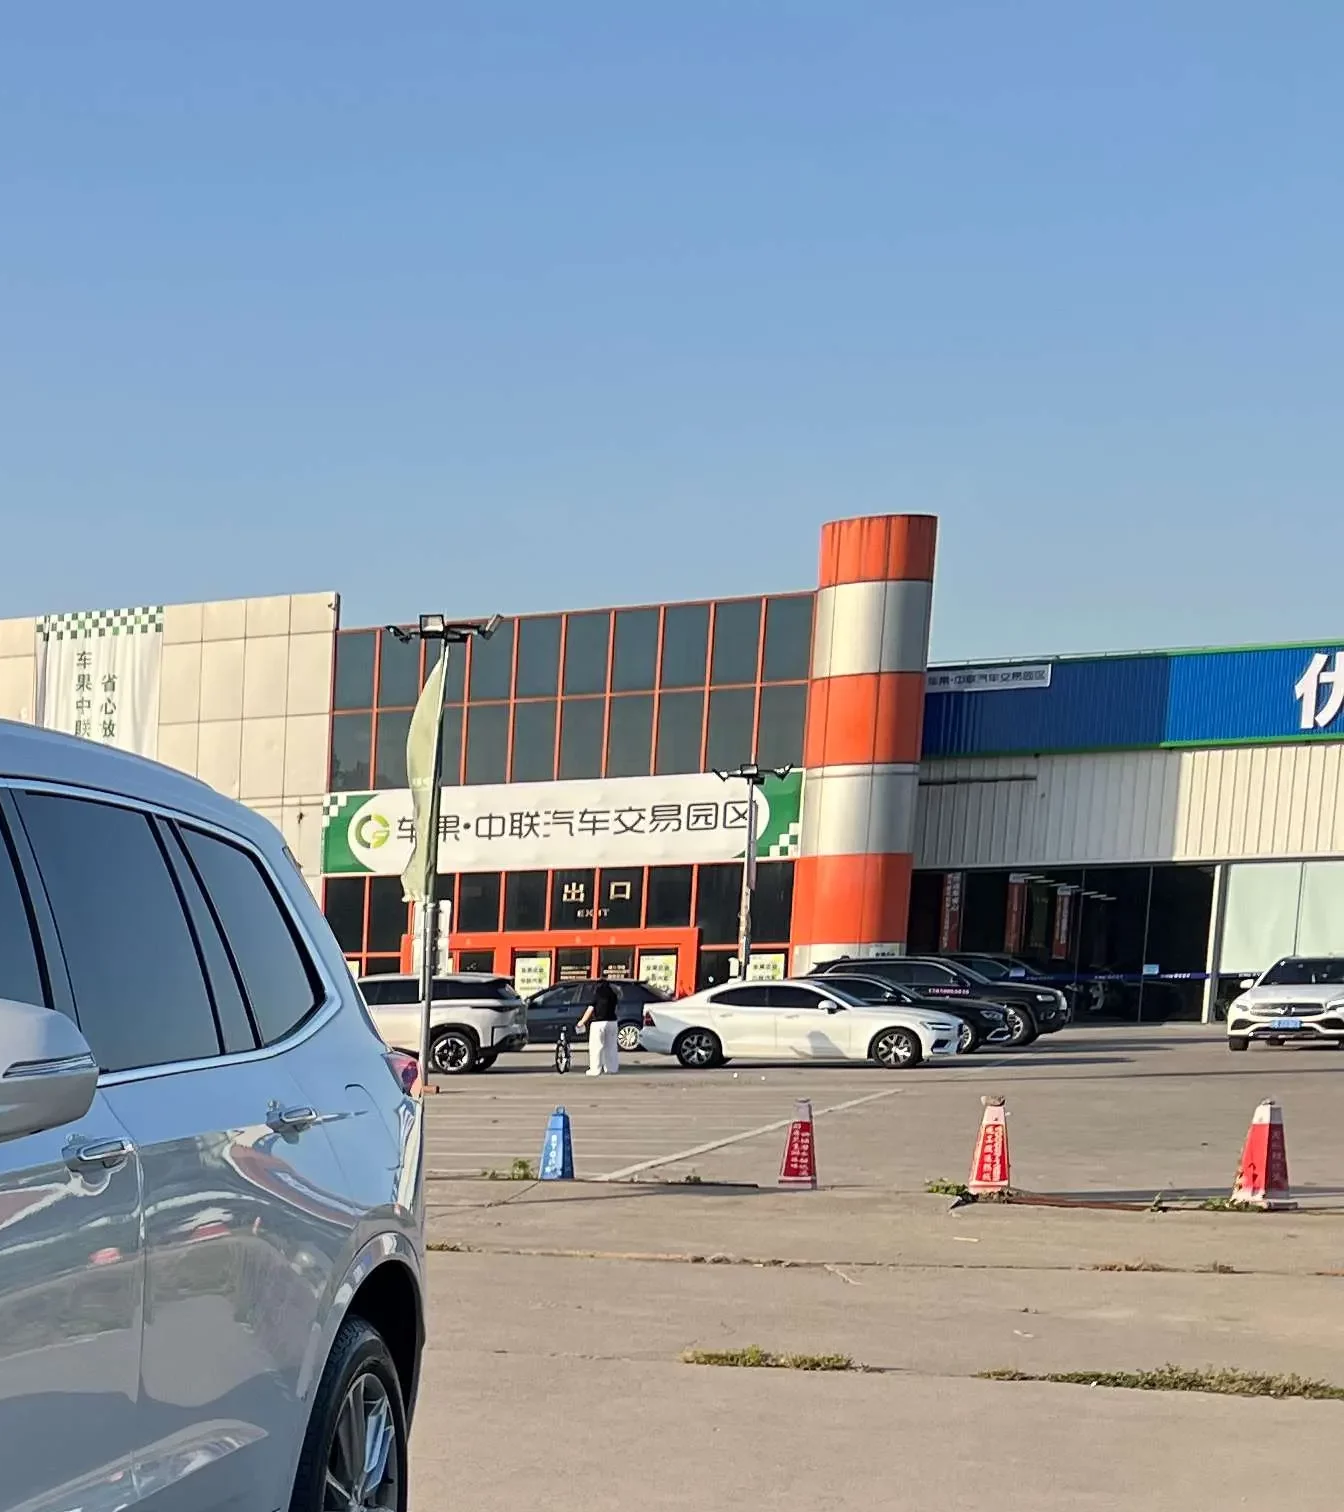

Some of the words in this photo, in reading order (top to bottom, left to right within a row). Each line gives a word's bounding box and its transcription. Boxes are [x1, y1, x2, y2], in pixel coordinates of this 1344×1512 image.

[75, 650, 92, 737] 车果中联
[99, 672, 118, 738] 省心放
[562, 881, 631, 902] 出口
[577, 908, 610, 918] EXIT
